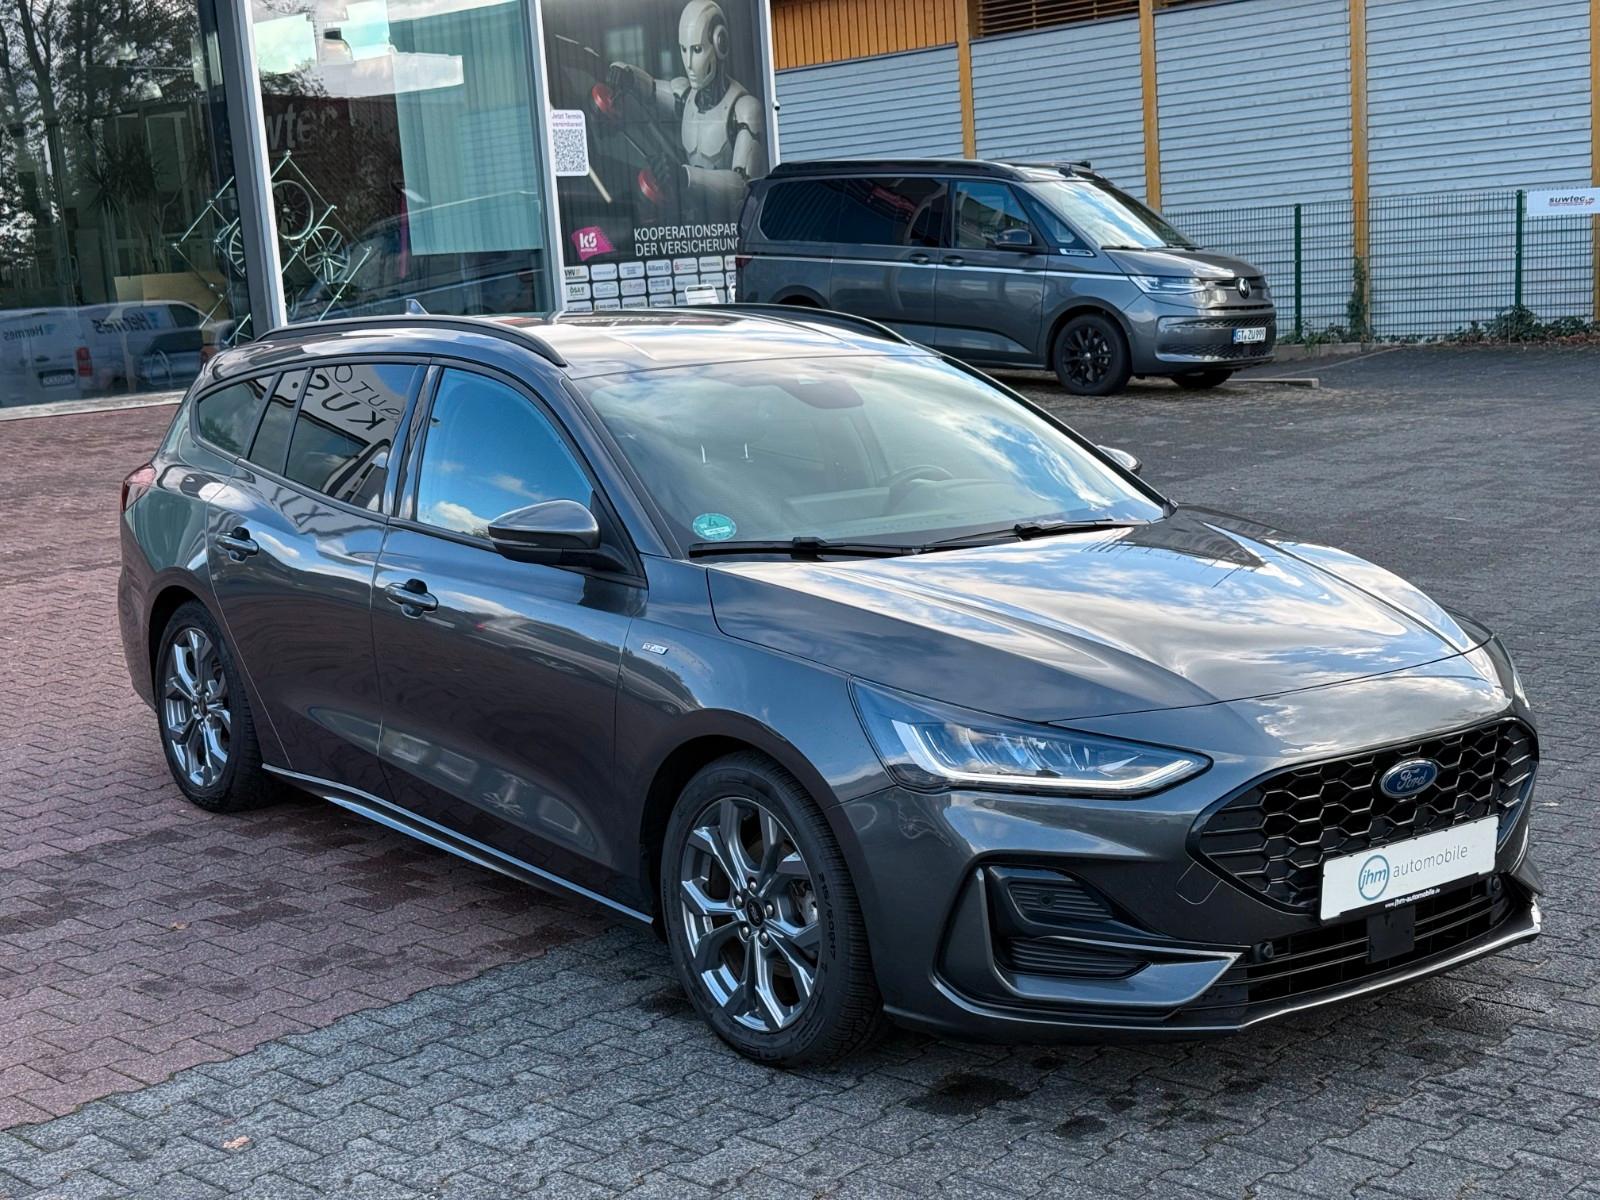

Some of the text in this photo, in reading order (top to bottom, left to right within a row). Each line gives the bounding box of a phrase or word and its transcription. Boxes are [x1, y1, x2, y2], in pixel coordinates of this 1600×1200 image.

[635, 242, 659, 257] DER
[1396, 768, 1426, 790] Ford
[1393, 844, 1468, 878] automobile
